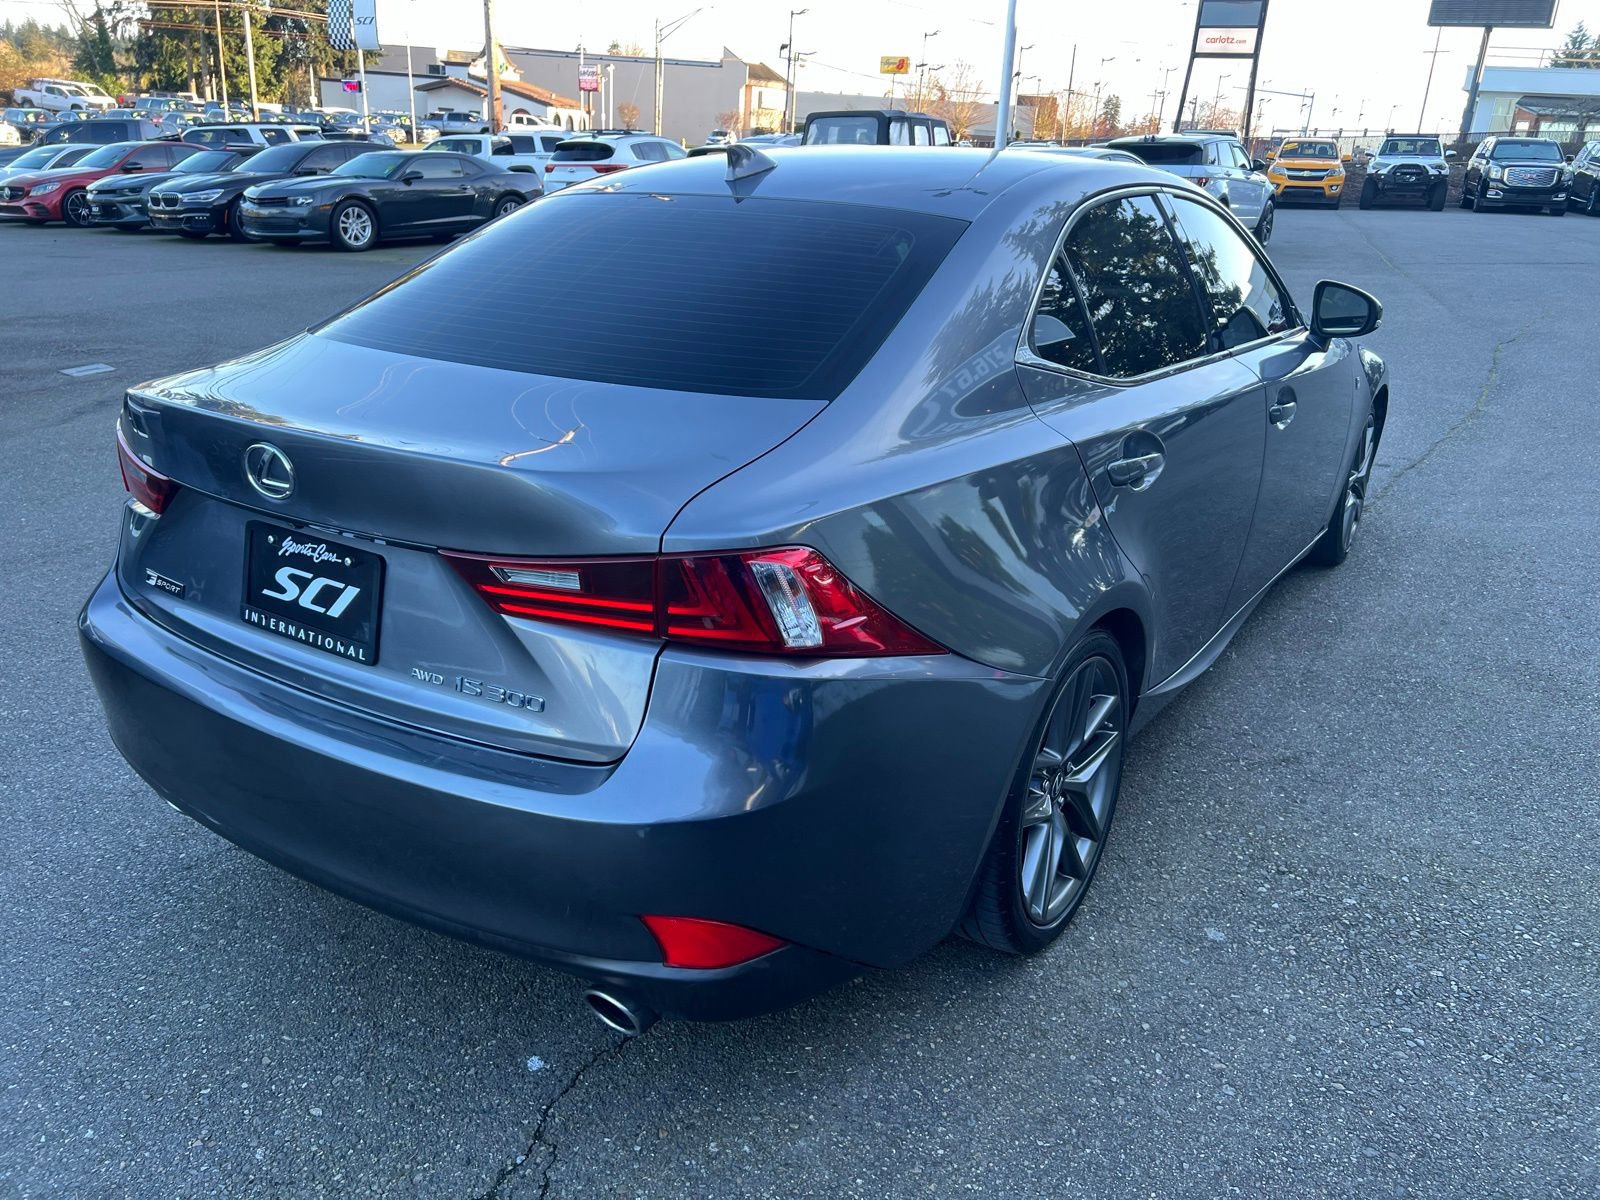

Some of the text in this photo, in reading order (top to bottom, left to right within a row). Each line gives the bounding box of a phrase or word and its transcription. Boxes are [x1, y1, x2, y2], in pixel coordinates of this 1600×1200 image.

[355, 16, 375, 26] SCI
[278, 535, 342, 563] Sports Cars
[156, 579, 181, 593] SPORT
[261, 566, 361, 619] SCI
[244, 608, 367, 661] INTERNATIONAL
[411, 667, 445, 686] AWD
[486, 684, 546, 713] 300
